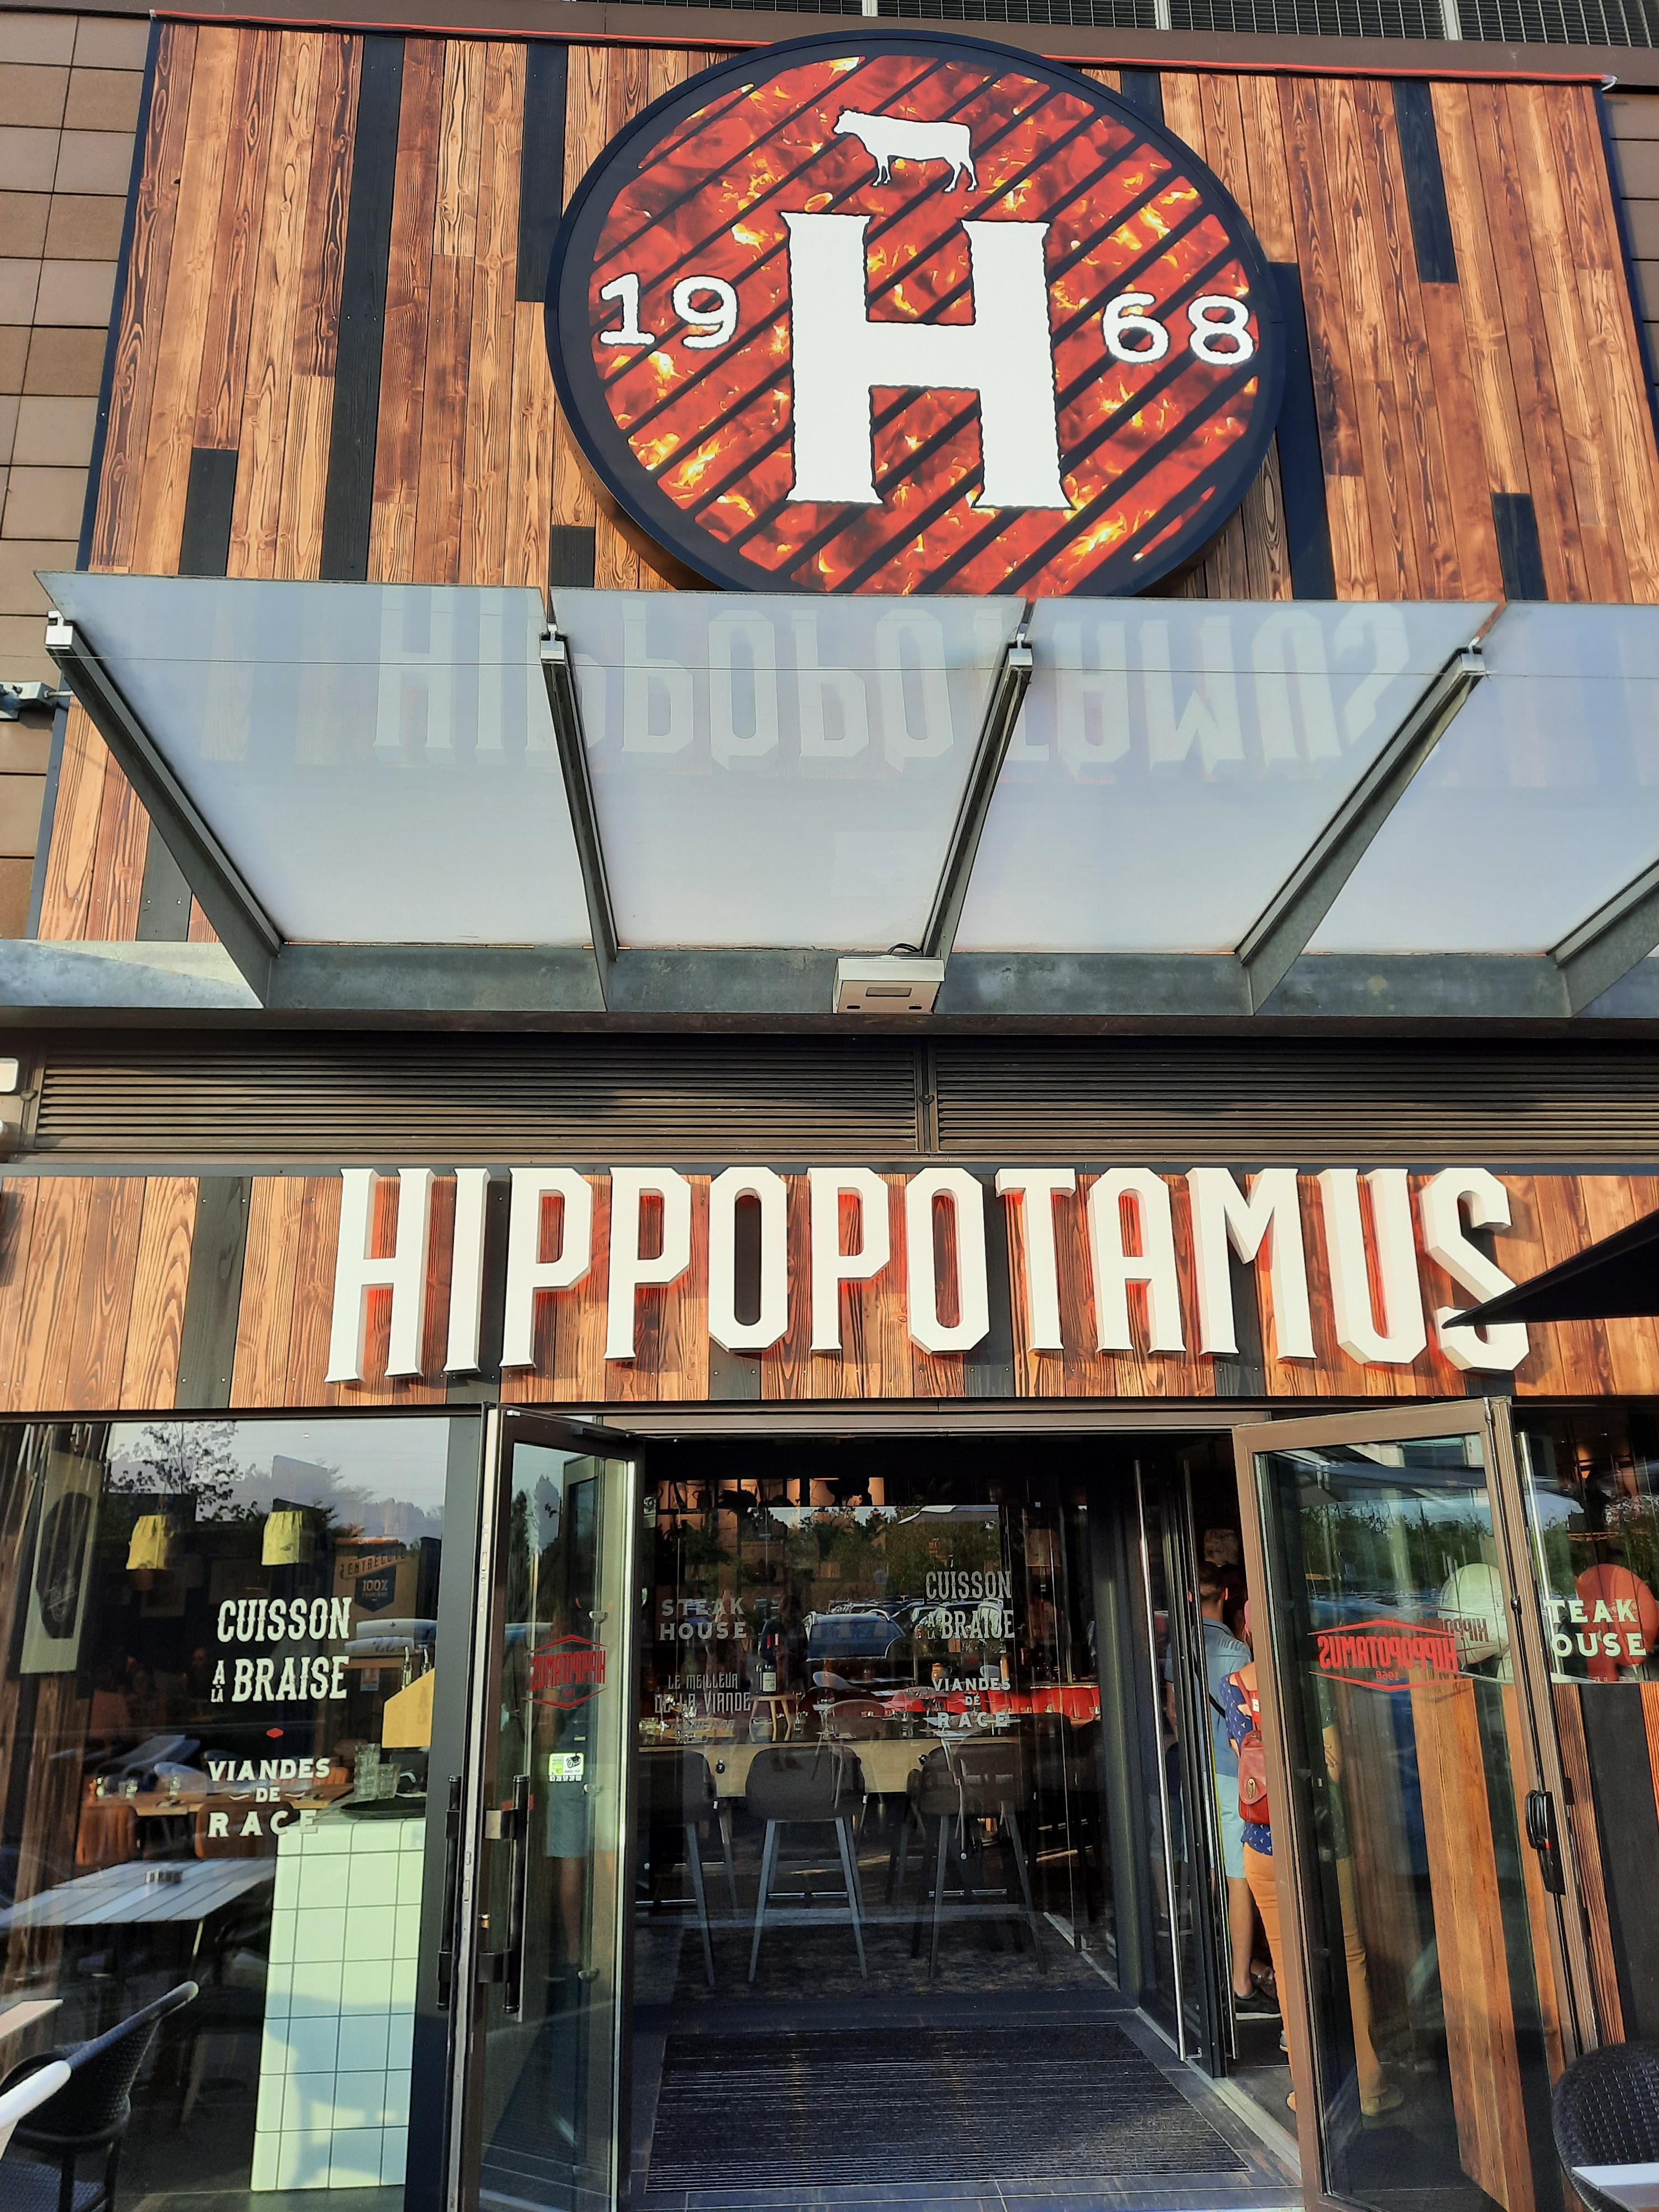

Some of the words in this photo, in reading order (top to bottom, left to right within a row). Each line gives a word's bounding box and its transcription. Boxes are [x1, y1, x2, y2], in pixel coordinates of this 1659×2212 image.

[598, 273, 739, 349] 19
[778, 211, 1076, 510] H
[1100, 292, 1255, 366] 68
[325, 1166, 1531, 1384] HIPPOPOTAMUS
[363, 1579, 388, 1592] 100%
[926, 1571, 1011, 1599] CUISSON
[661, 1598, 744, 1616] STEAK
[1543, 1599, 1638, 1624] TEAK
[217, 1597, 352, 1642] CUISSON
[659, 1622, 747, 1641] HOUSE
[1551, 1632, 1647, 1657] OUSE
[211, 1688, 223, 1703] LA
[232, 1656, 349, 1702] BRAISE
[668, 1674, 681, 1689] LE
[686, 1671, 738, 1691] MEILLEUR
[932, 1677, 1011, 1692] VIANDES
[704, 1692, 751, 1714] VIANDE
[965, 1695, 981, 1706] DE
[937, 1712, 1010, 1728] RACE
[207, 1757, 331, 1782] VIANDES
[255, 1787, 280, 1803] DE
[207, 1809, 318, 1838] RACE
